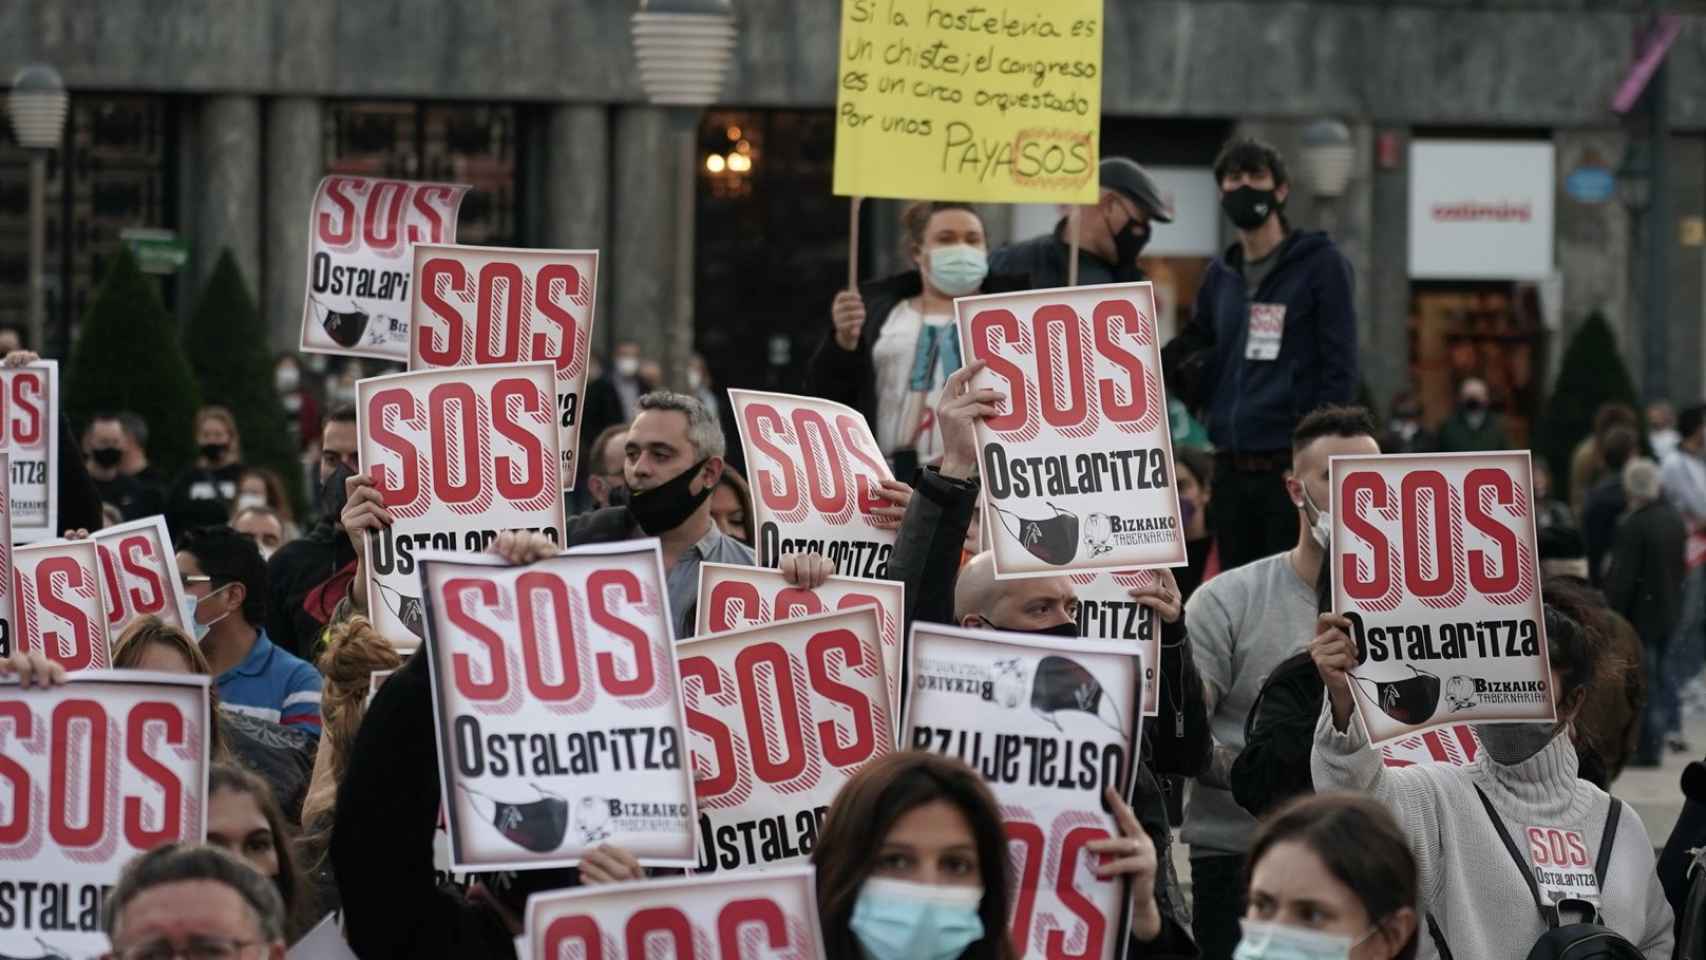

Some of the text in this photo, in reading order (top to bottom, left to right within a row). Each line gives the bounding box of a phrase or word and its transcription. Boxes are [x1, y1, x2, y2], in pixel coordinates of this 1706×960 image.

[888, 2, 909, 27] la
[1070, 20, 1097, 36] es
[999, 57, 1097, 88] congreso
[842, 71, 868, 92] es
[913, 81, 962, 104] circo
[881, 116, 933, 136] unos
[941, 121, 1089, 182] PAYASOS
[319, 178, 452, 248] SOS
[418, 257, 580, 371] SOS
[970, 298, 1149, 434] SOS
[368, 377, 546, 507] SOS
[743, 403, 892, 515] SOS
[1342, 468, 1520, 600] SOS
[443, 568, 655, 700] SOS
[678, 628, 875, 798] SOS
[0, 699, 184, 851] SOS
[1528, 828, 1586, 866] SOS
